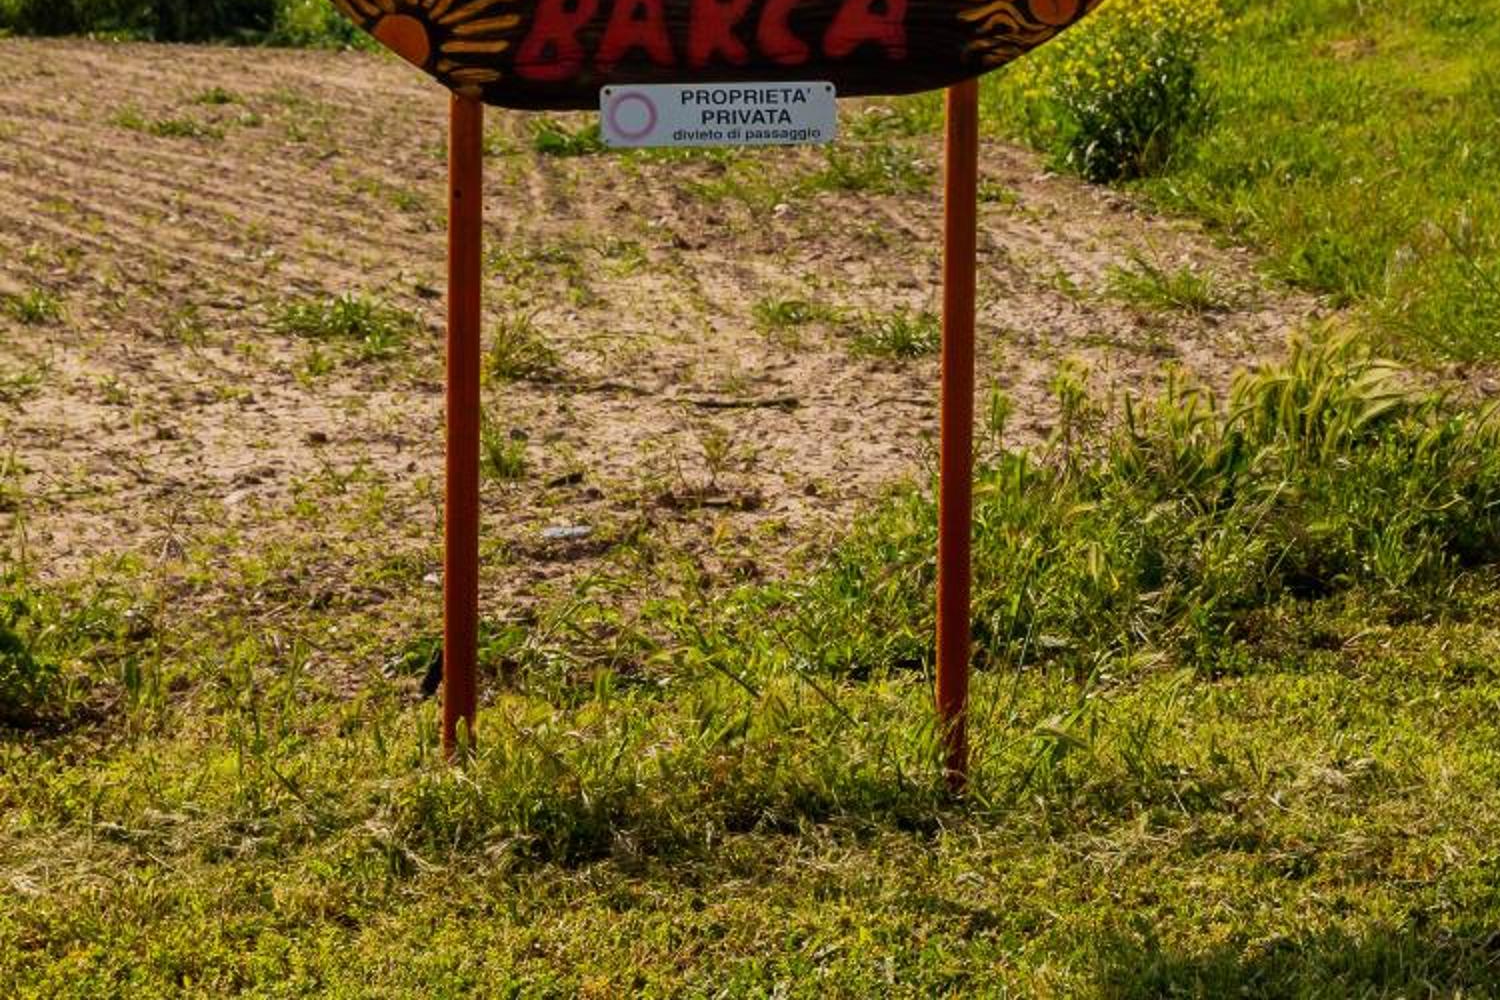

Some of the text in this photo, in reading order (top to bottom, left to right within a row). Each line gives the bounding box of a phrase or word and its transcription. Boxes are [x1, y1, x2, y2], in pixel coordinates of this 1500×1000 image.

[681, 88, 811, 105] PROPRIETA'
[701, 109, 792, 125] PRIVATA
[673, 127, 821, 142] divieto di passaggio
